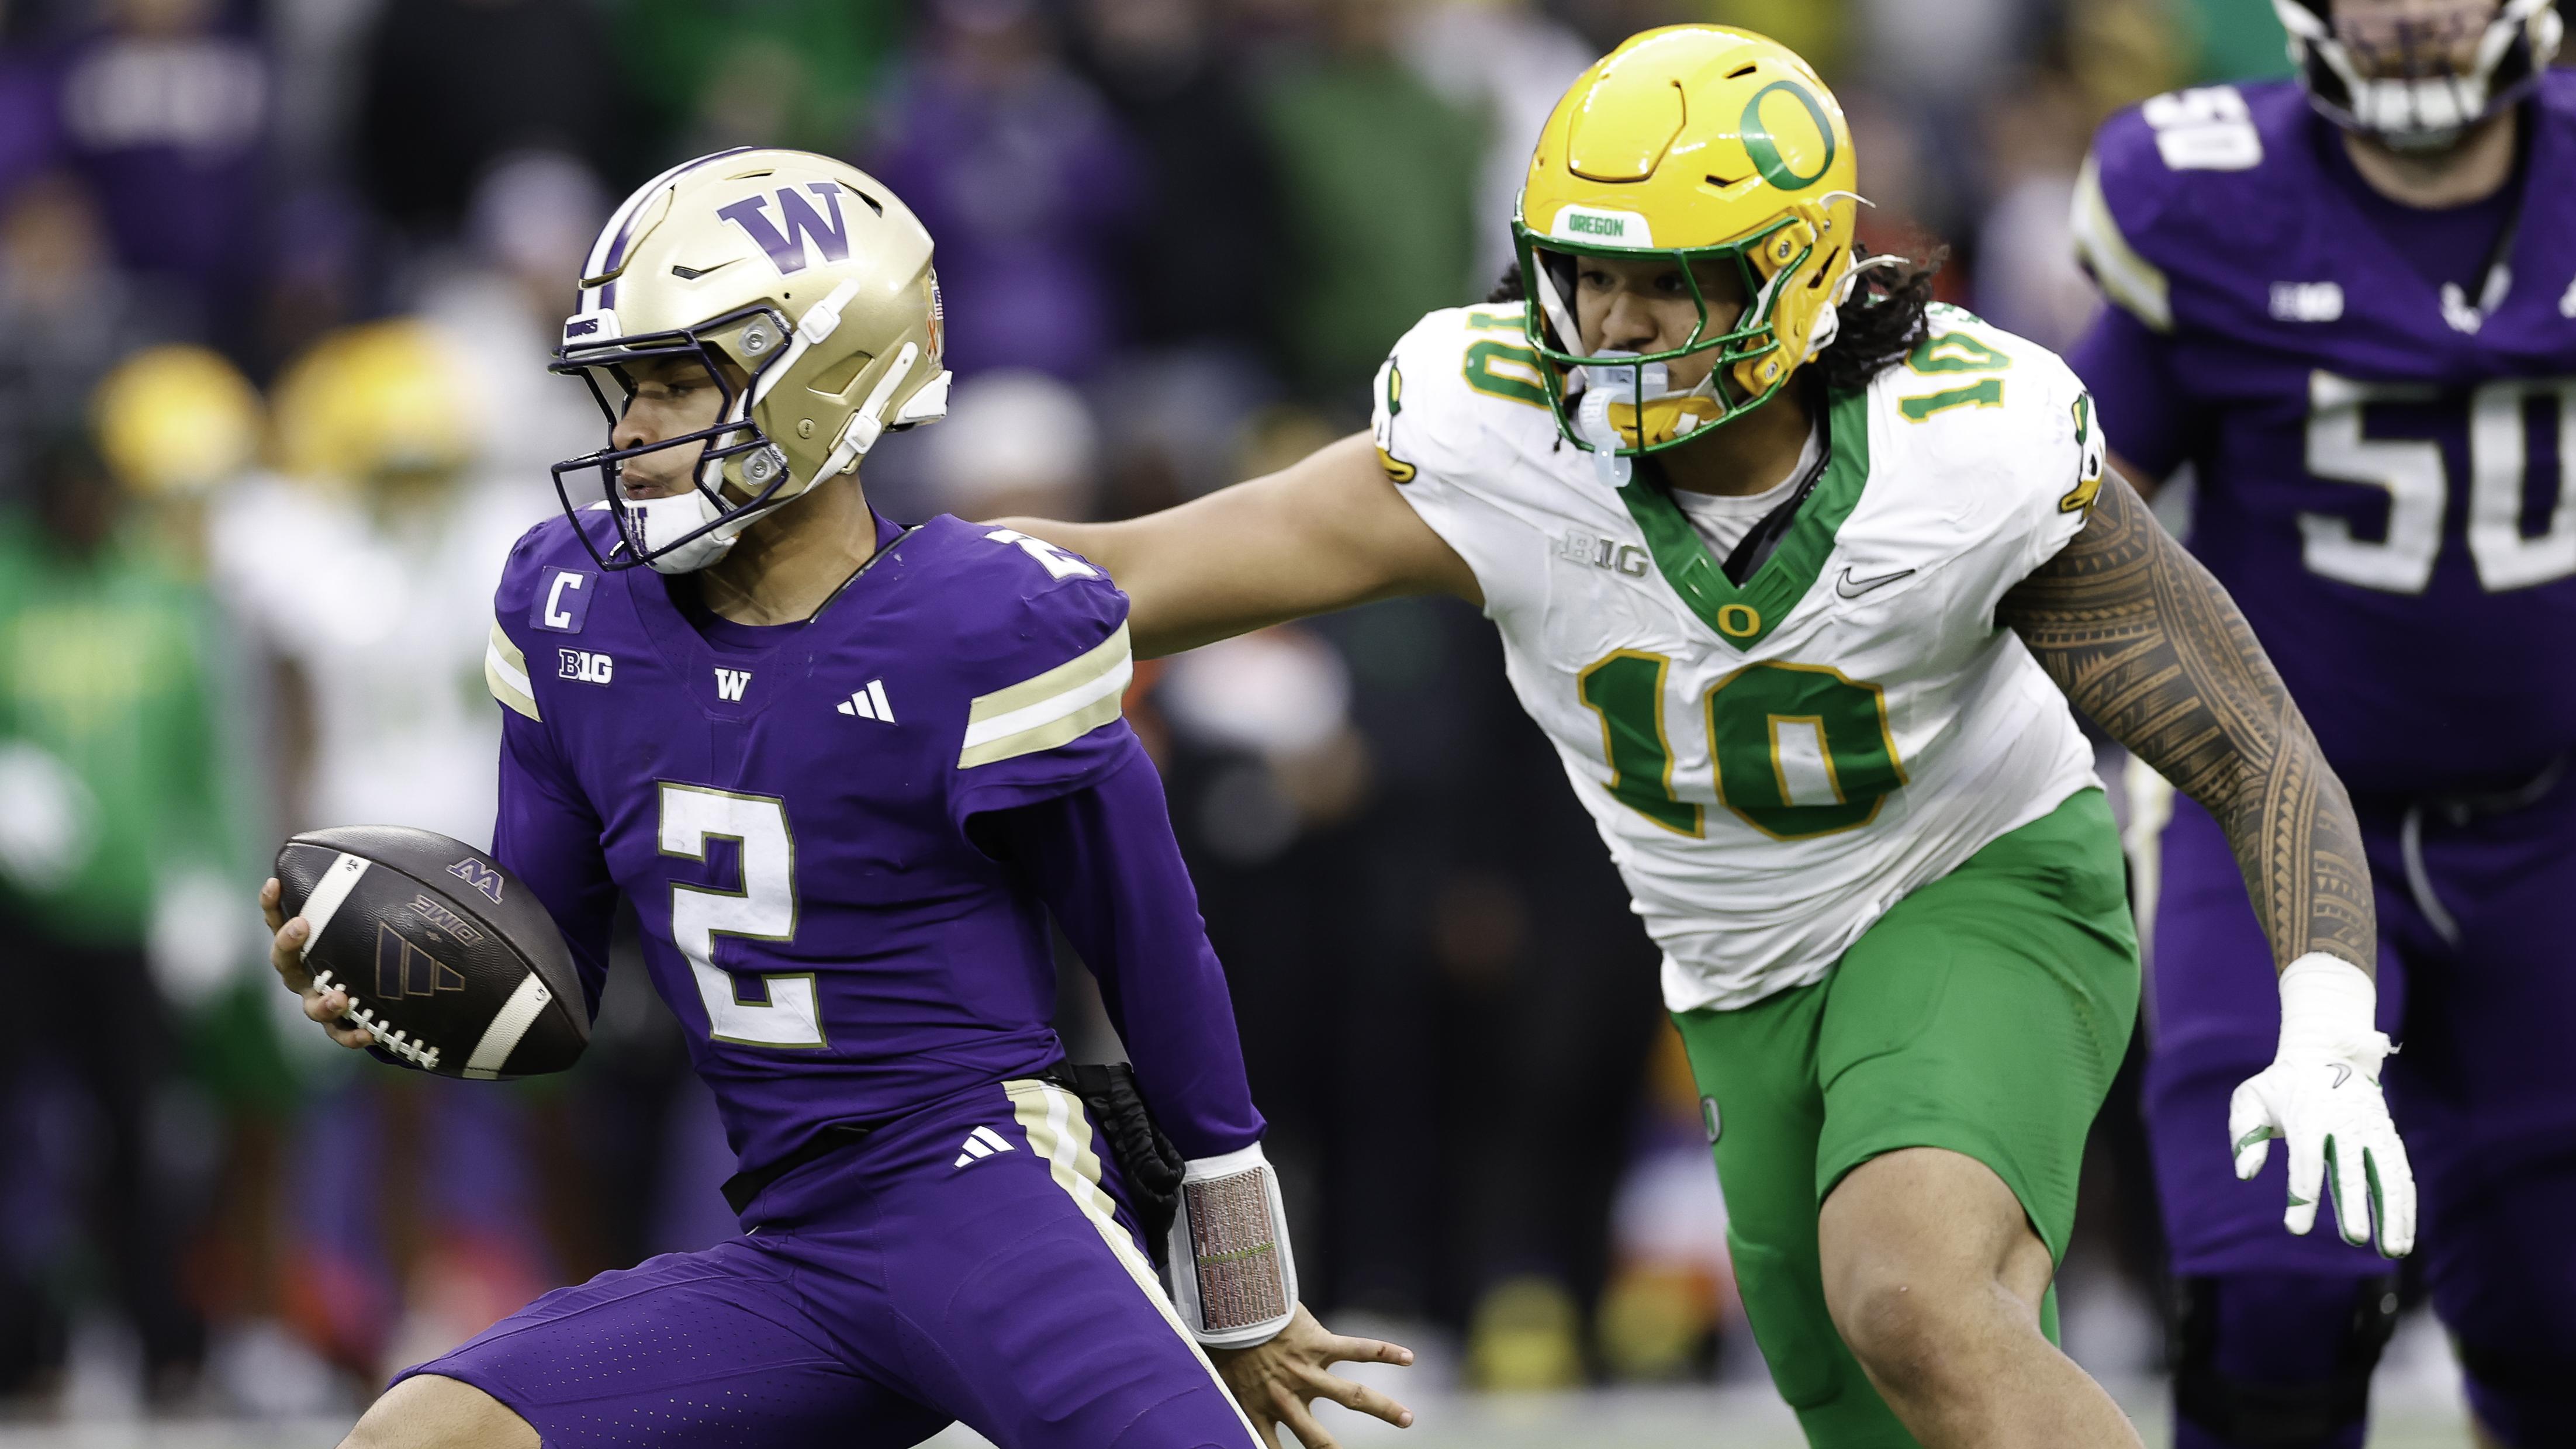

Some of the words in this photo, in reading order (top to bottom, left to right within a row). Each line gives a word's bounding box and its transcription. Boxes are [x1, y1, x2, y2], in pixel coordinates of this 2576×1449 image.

[715, 182, 852, 278] W
[1569, 214, 1624, 237] OREGON
[2297, 369, 2576, 595] 50
[544, 570, 584, 630] C
[714, 667, 752, 702] W
[1576, 647, 1910, 842] 10
[445, 856, 505, 906] W
[657, 781, 828, 1048] 2
